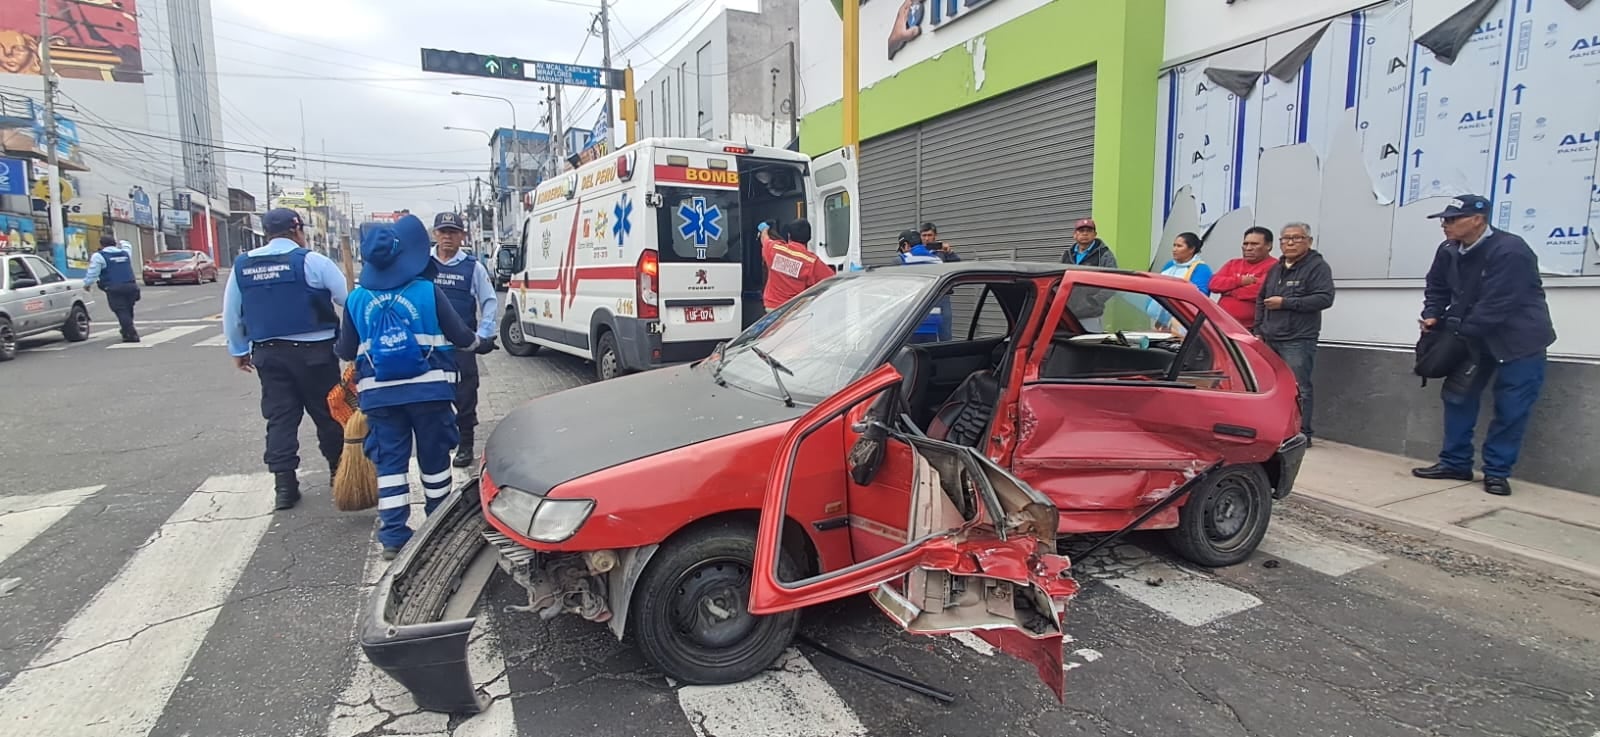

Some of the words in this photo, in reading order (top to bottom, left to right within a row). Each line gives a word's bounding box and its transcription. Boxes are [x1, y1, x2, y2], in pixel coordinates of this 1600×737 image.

[537, 69, 573, 78] MIRAFLORES
[581, 174, 593, 190] DEL
[686, 167, 739, 184] BOMB
